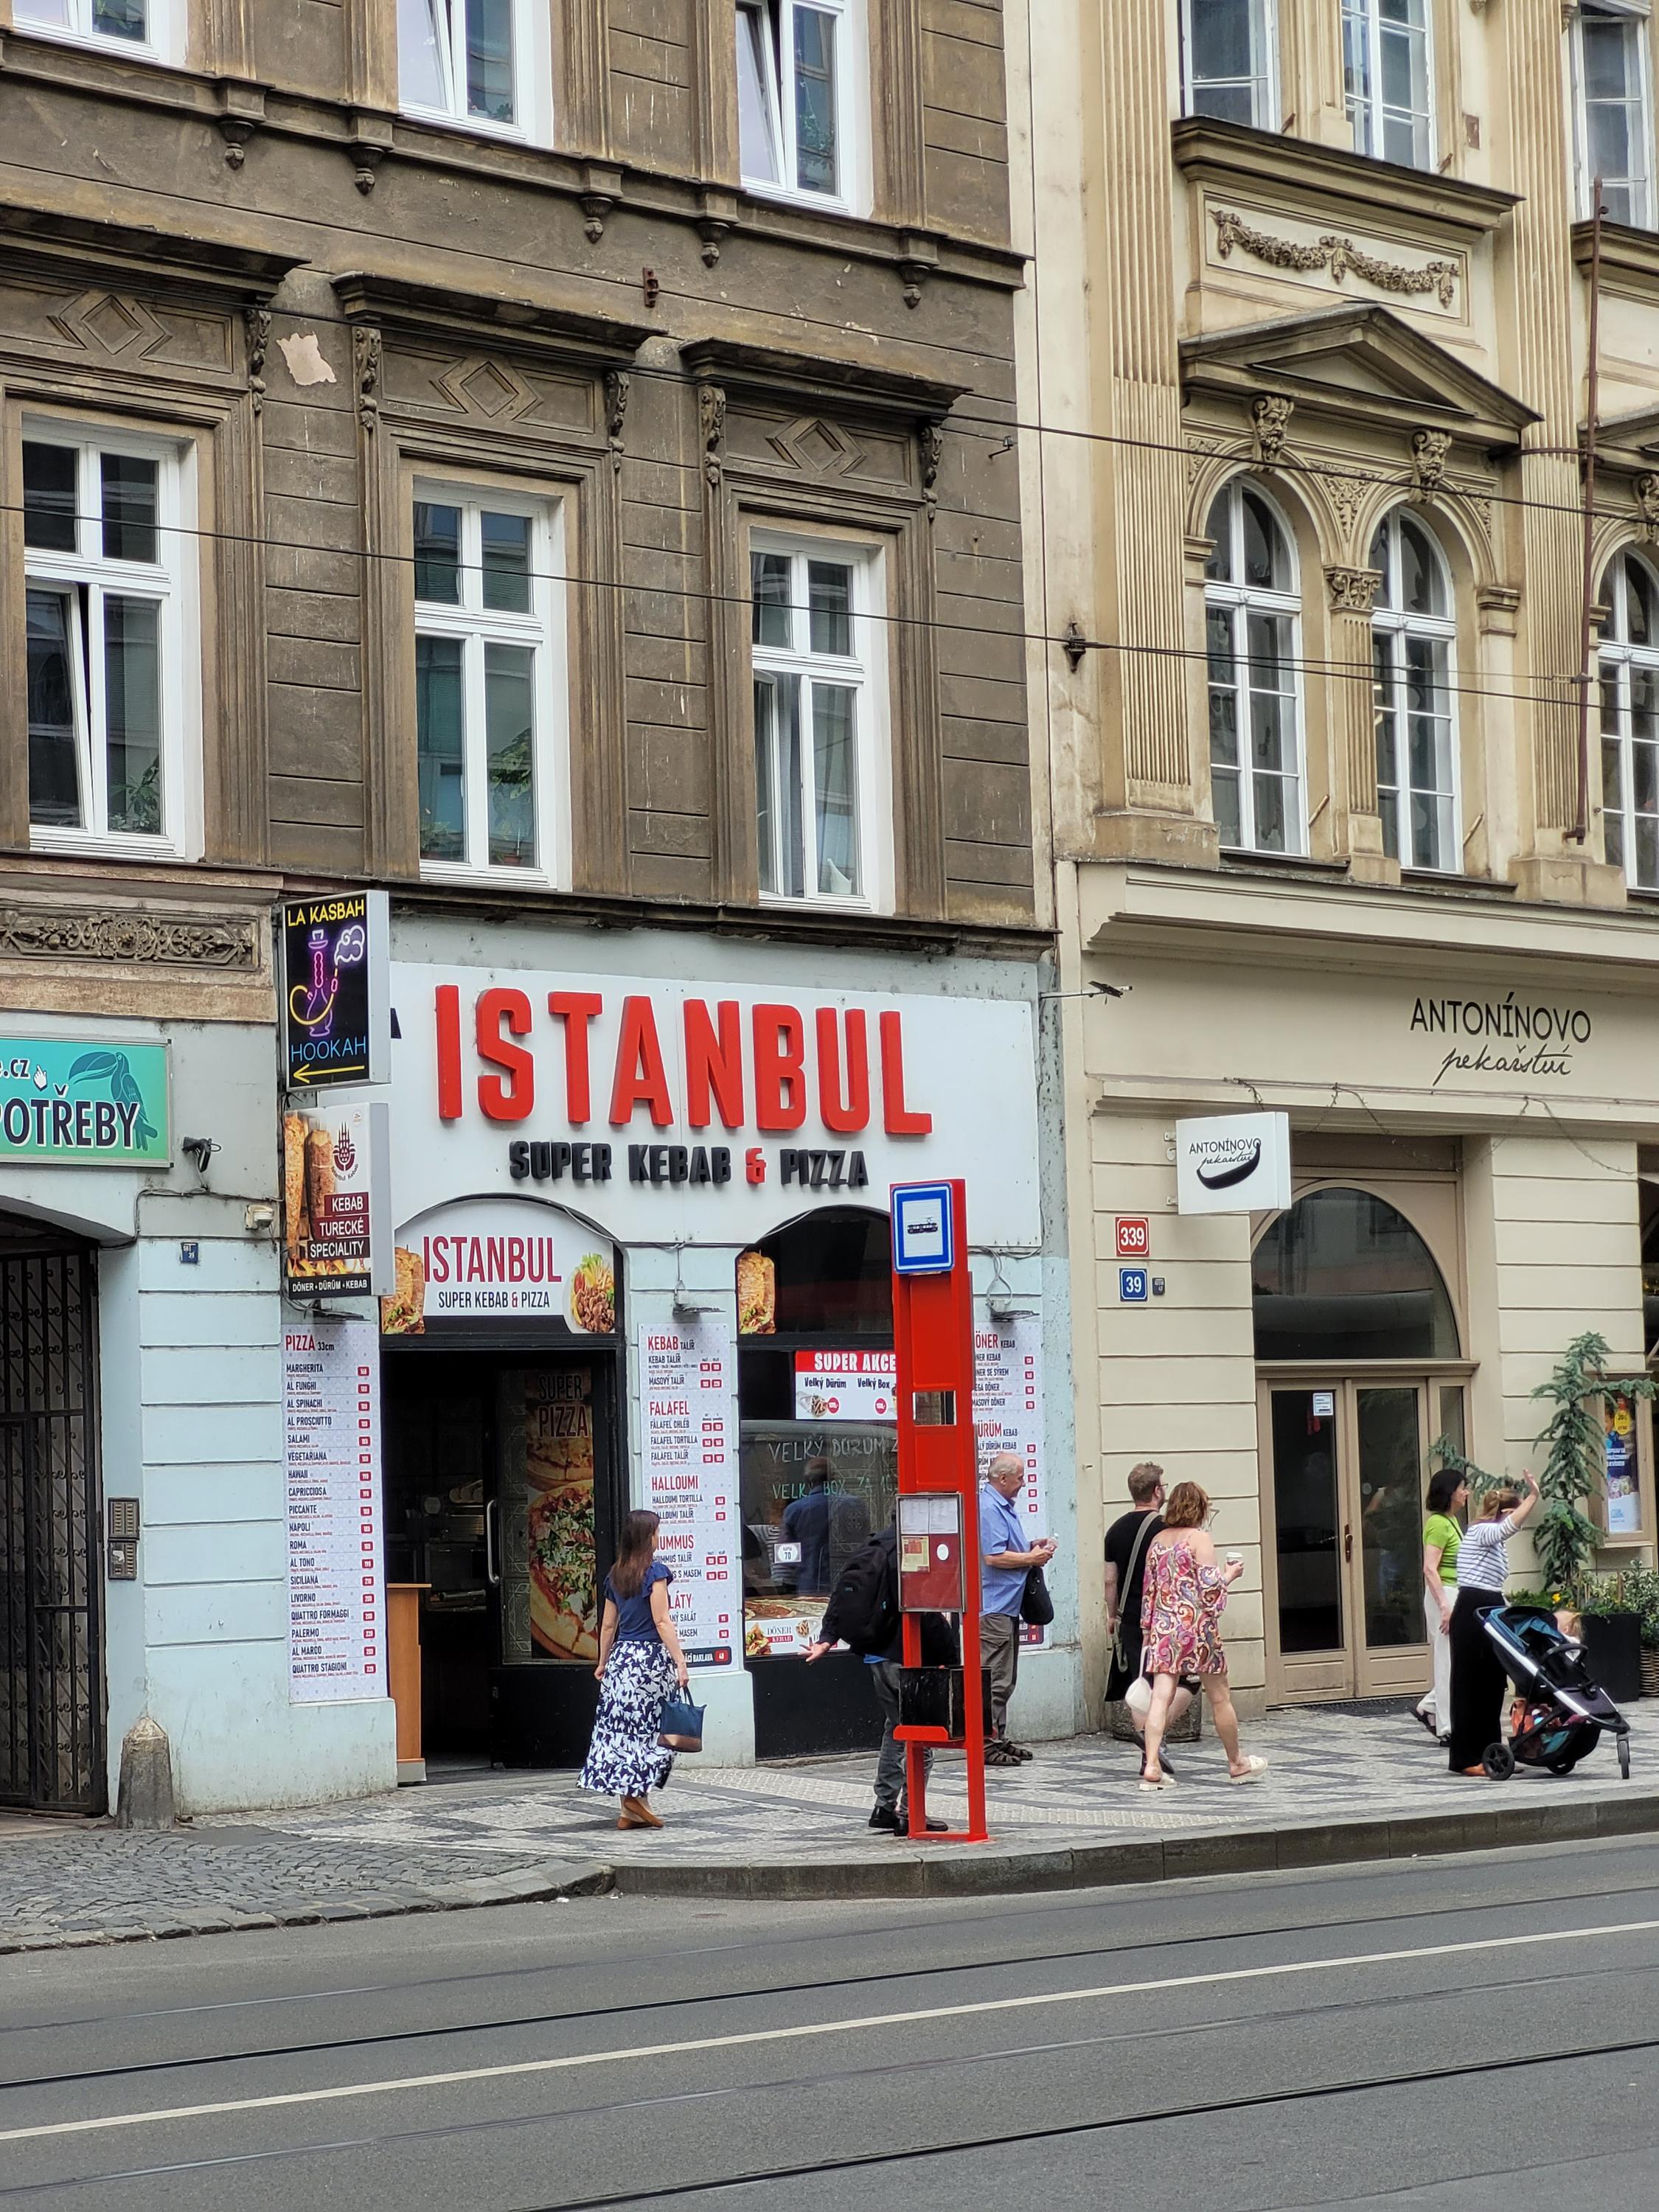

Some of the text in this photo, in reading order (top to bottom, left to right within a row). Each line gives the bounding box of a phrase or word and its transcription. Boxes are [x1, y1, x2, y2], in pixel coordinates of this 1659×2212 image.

[288, 899, 364, 927] LA KASBAH
[1410, 991, 1591, 1043] ANTONÍNOVO
[291, 1035, 366, 1062] HOOKAH
[435, 984, 932, 1135] ISTANBUL
[1433, 1043, 1573, 1086] pekařství
[0, 1084, 139, 1147] OTŘEBY
[1189, 1138, 1262, 1155] ANTONÍNOVO
[509, 1140, 869, 1186] SUPER KEBAB & PIZZA
[332, 1196, 364, 1212] KEBAB
[319, 1217, 364, 1237] TURECKÉ
[1121, 1227, 1145, 1246] 339
[310, 1240, 364, 1258] SPECIALITY
[423, 1236, 562, 1283] ISTANBUL
[293, 1281, 314, 1293] DÖNER
[346, 1279, 367, 1289] KEBAB
[1126, 1276, 1141, 1293] 39
[438, 1291, 550, 1308] SUPER KEBAB & PIZZA
[285, 1335, 334, 1351] PIZZA 33cm
[648, 1336, 695, 1350] KEBAB TALÍŘ
[975, 1331, 998, 1348] ÖNER
[667, 1353, 681, 1363] TALÍŘ
[815, 1353, 896, 1371] SUPER AKCE
[286, 1364, 323, 1373] MARGHERITA
[671, 1374, 685, 1385] TALÍŘ
[804, 1377, 824, 1390] Velký
[858, 1377, 890, 1390] Velký Box
[287, 1381, 316, 1391] AL FUNGHI
[539, 1374, 583, 1400] SUPER
[975, 1384, 984, 1392] EGA
[287, 1399, 322, 1408] AL SPINACHI
[650, 1401, 689, 1416] FALAFEL
[288, 1416, 332, 1425] AL PROSCIUTTO
[538, 1405, 589, 1438] PIZZA
[650, 1420, 672, 1429] FALAFEL
[978, 1419, 1002, 1437] ÜRÜM
[288, 1435, 310, 1443] SALAMI
[651, 1436, 698, 1444] FALAFEL TORTILLA
[768, 1436, 824, 1463] VELKÝ
[288, 1452, 327, 1461] VEGETARIANA
[651, 1450, 689, 1461] FALAFEL TALÍŘ
[288, 1470, 307, 1478] HAWAII
[652, 1475, 698, 1491] HALLOUMI
[288, 1487, 327, 1496] CAPRICCIOSA
[653, 1495, 703, 1504] HALLOUMI TORTILLA
[289, 1505, 317, 1514] PICCANTE
[655, 1508, 694, 1519] ALLOUMI TALÍŘ
[289, 1523, 310, 1531] NAPOLI
[290, 1540, 307, 1549] ROMA
[678, 1552, 692, 1562] TALÍŘ
[785, 1552, 791, 1560] 70
[290, 1559, 297, 1567] AL
[299, 1558, 315, 1567] TONO
[683, 1569, 702, 1578] MASEM
[291, 1576, 319, 1585] SICILIANA
[291, 1593, 316, 1603] LIVORNO
[669, 1590, 692, 1609] LÁTY
[291, 1610, 318, 1620] QUATTRO
[320, 1610, 349, 1618] FORMAGGI
[680, 1611, 697, 1621] SALÁT
[292, 1628, 319, 1638] PALERMO
[679, 1628, 698, 1638] MASEM
[767, 1626, 792, 1635] DÖNER
[292, 1647, 299, 1656] AL
[301, 1646, 321, 1655] MARCO
[292, 1664, 319, 1674] QUATTRO
[321, 1662, 347, 1672] STAGIONI
